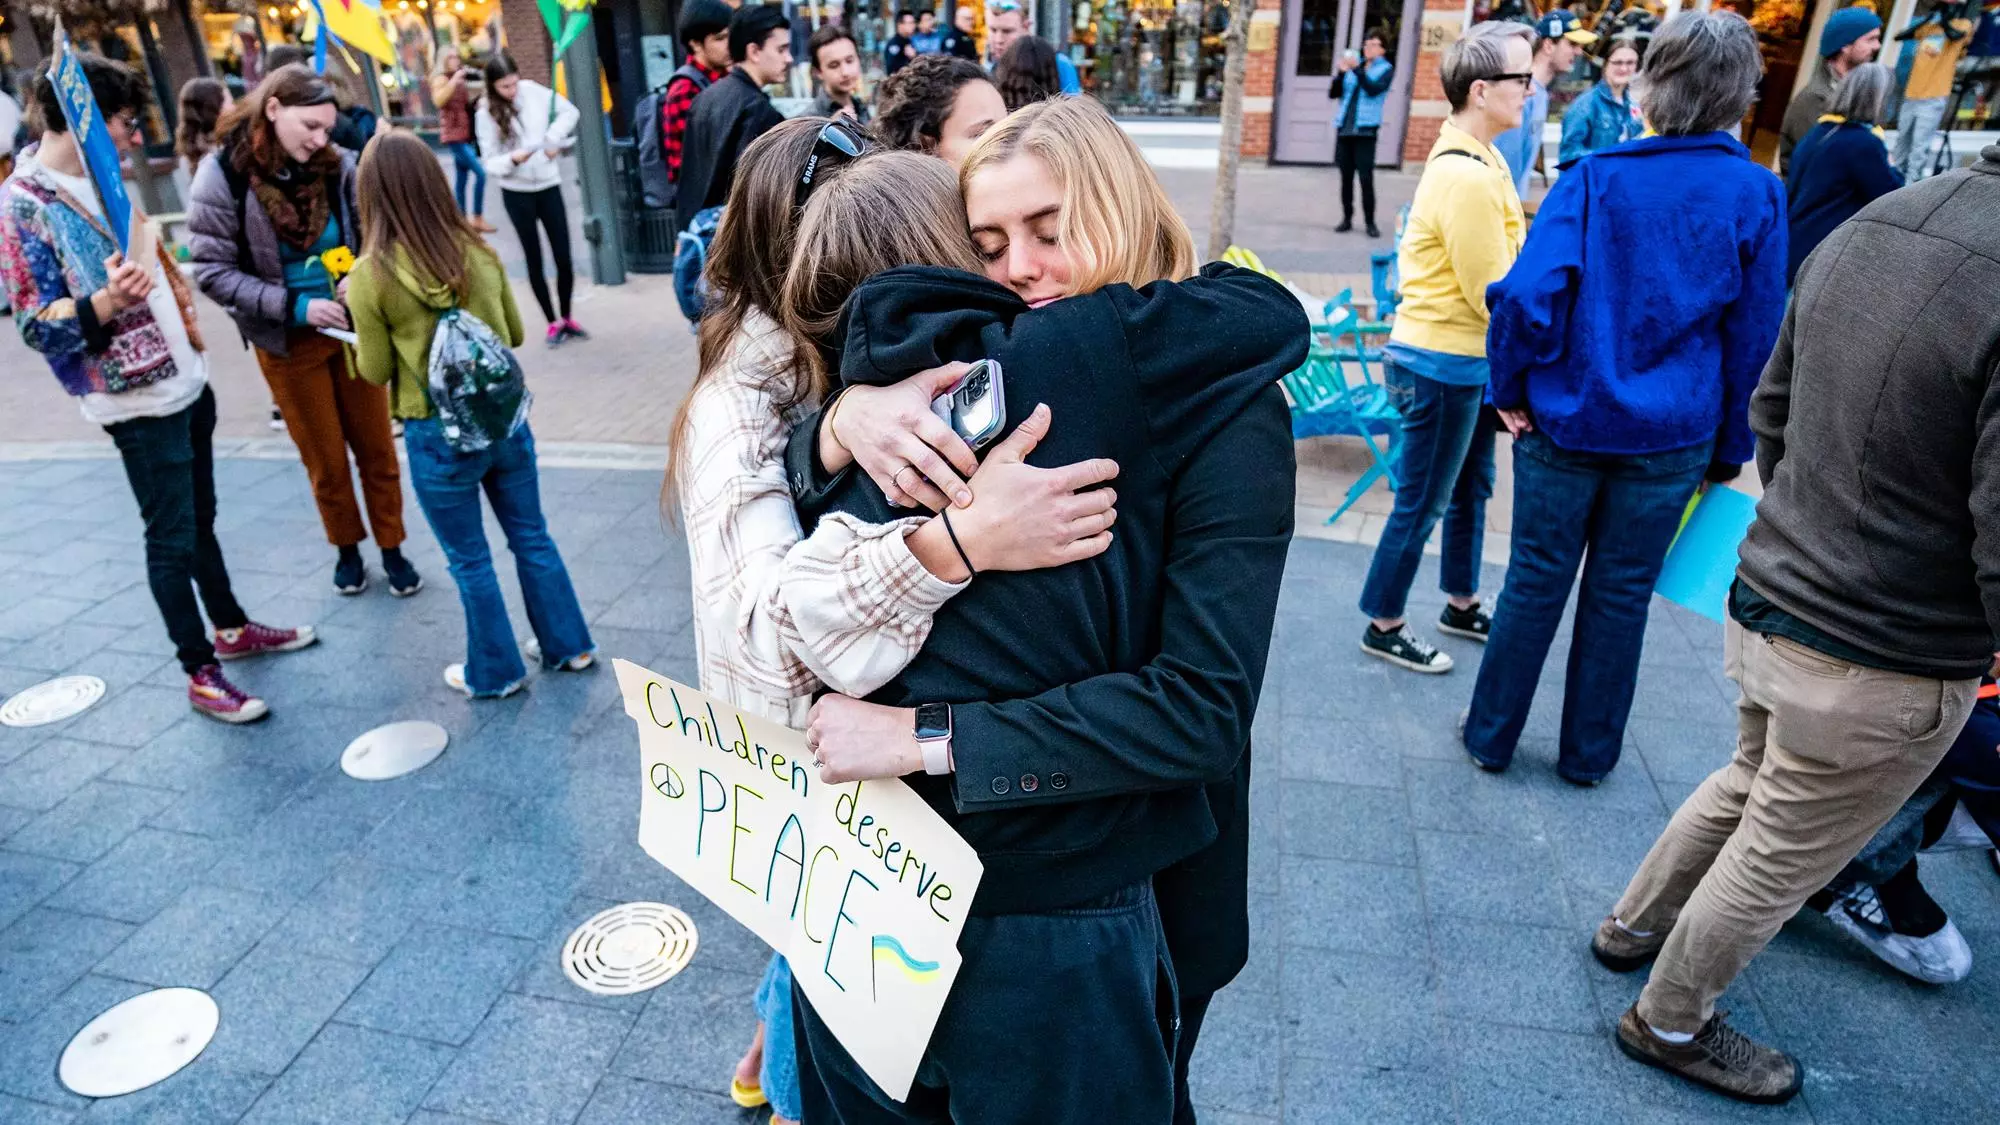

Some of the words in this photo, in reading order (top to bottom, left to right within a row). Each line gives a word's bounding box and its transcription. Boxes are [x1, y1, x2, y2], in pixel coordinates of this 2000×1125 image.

[804, 154, 818, 177] RAMS
[646, 681, 809, 797] Children
[835, 780, 953, 922] deserve
[696, 768, 880, 992] PEACE
